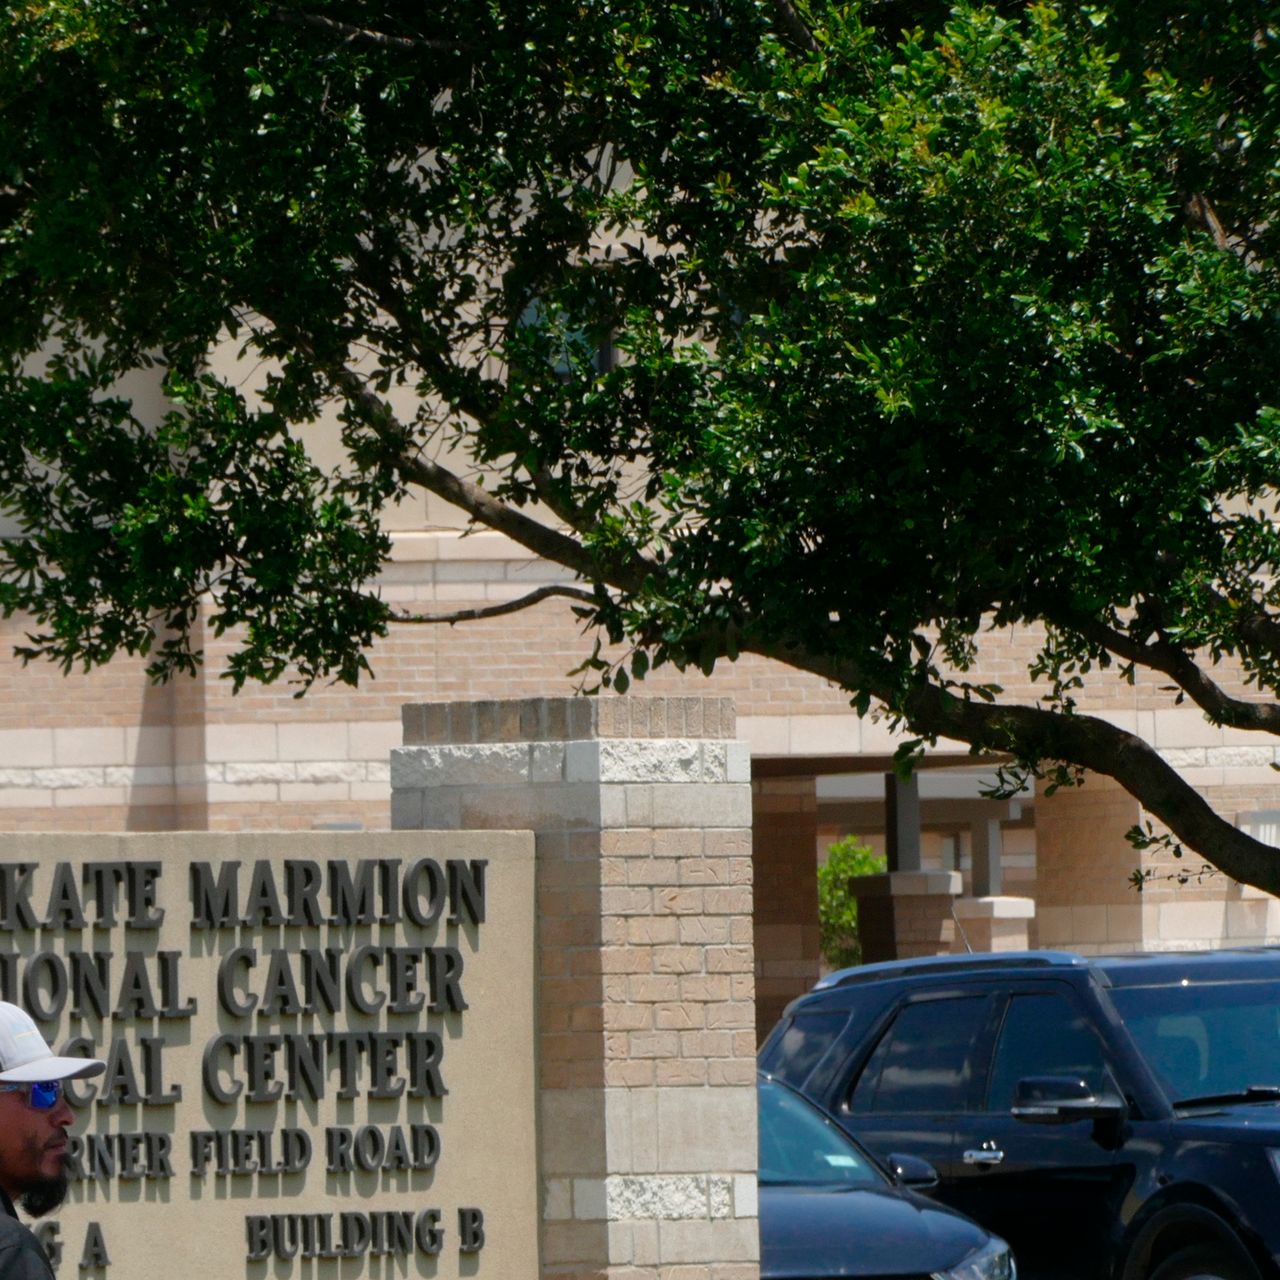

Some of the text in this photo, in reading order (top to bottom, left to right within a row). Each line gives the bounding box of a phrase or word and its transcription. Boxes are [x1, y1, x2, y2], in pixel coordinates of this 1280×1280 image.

[190, 857, 489, 930] MARMION
[217, 945, 469, 1018] CANCER
[202, 1031, 449, 1104] CENTER
[66, 1124, 441, 1180] RNER FIELD ROAD
[79, 1221, 112, 1267] A
[246, 1207, 486, 1261] BUILDING B
